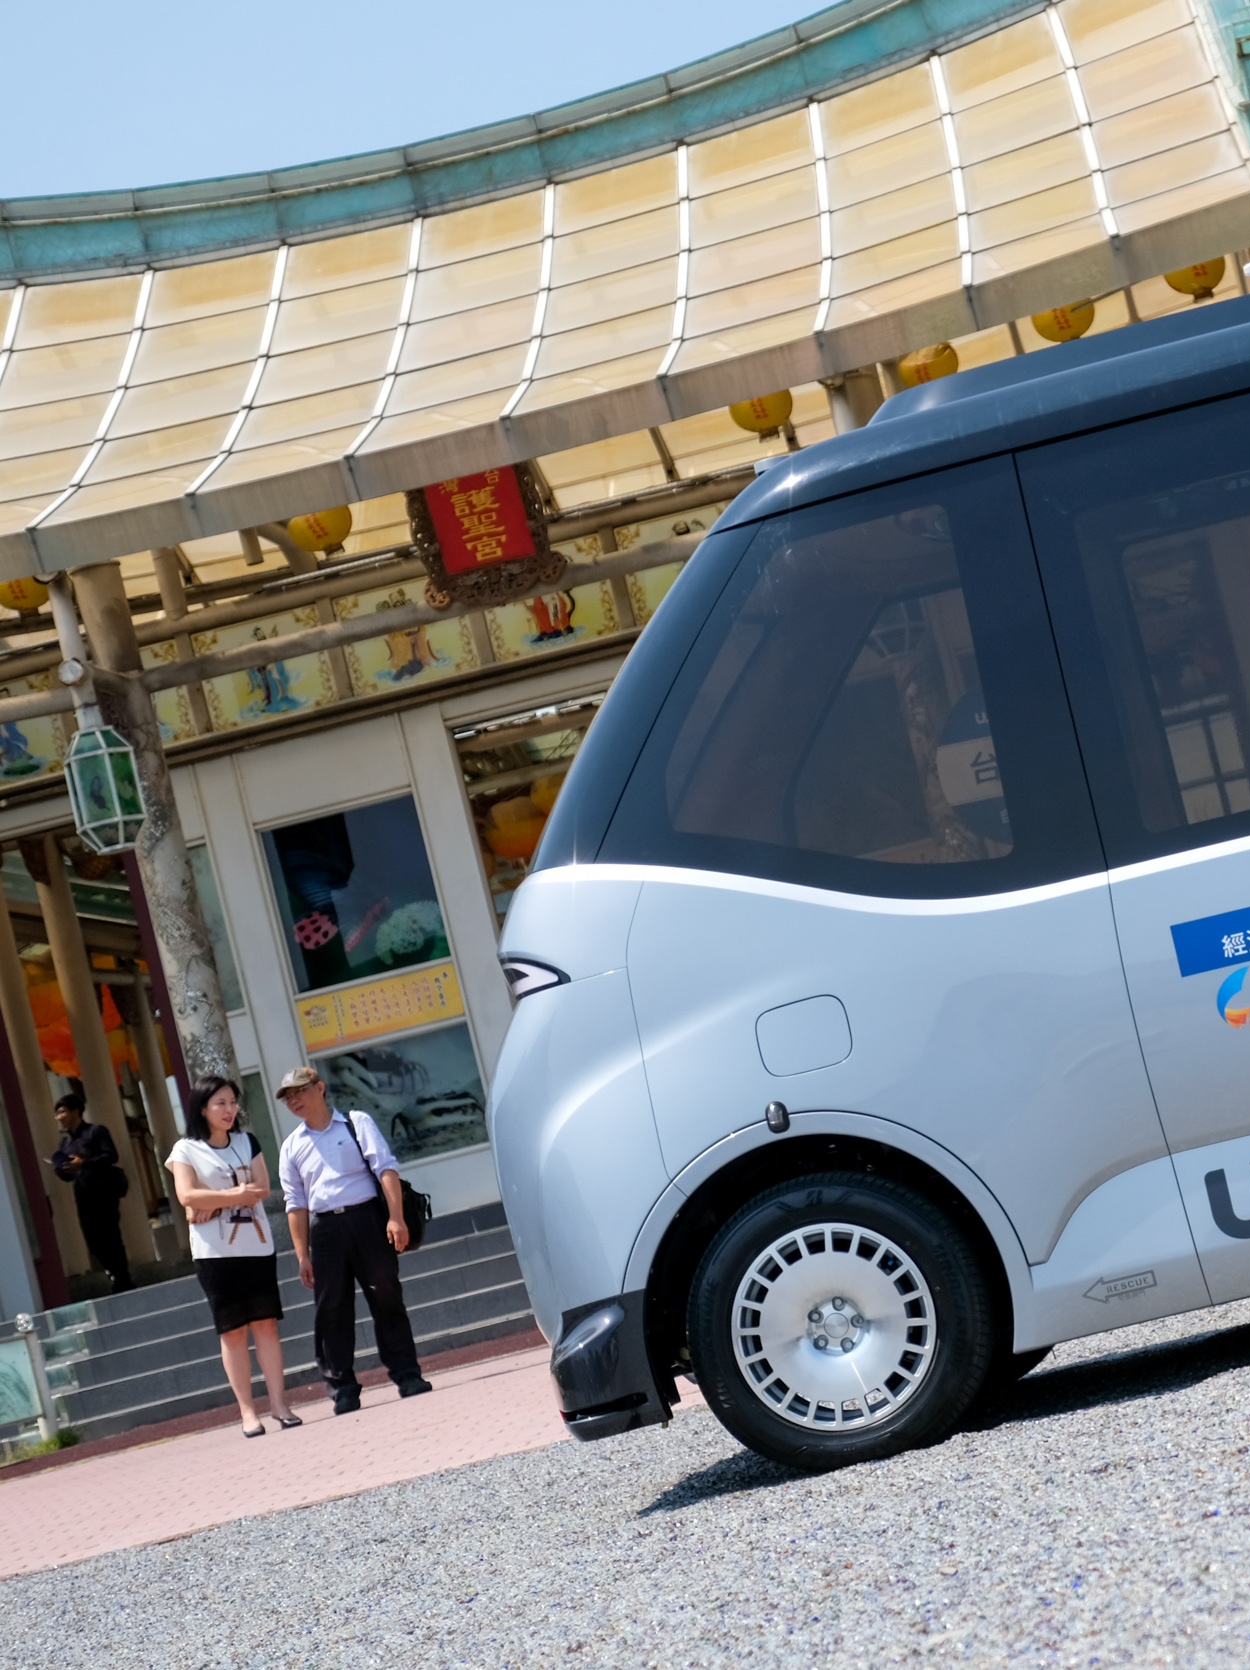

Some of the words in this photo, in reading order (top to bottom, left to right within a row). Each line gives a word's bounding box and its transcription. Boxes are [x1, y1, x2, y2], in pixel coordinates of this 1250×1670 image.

[450, 485, 507, 562] 護聖宮
[1106, 1276, 1150, 1294] RESCUE
